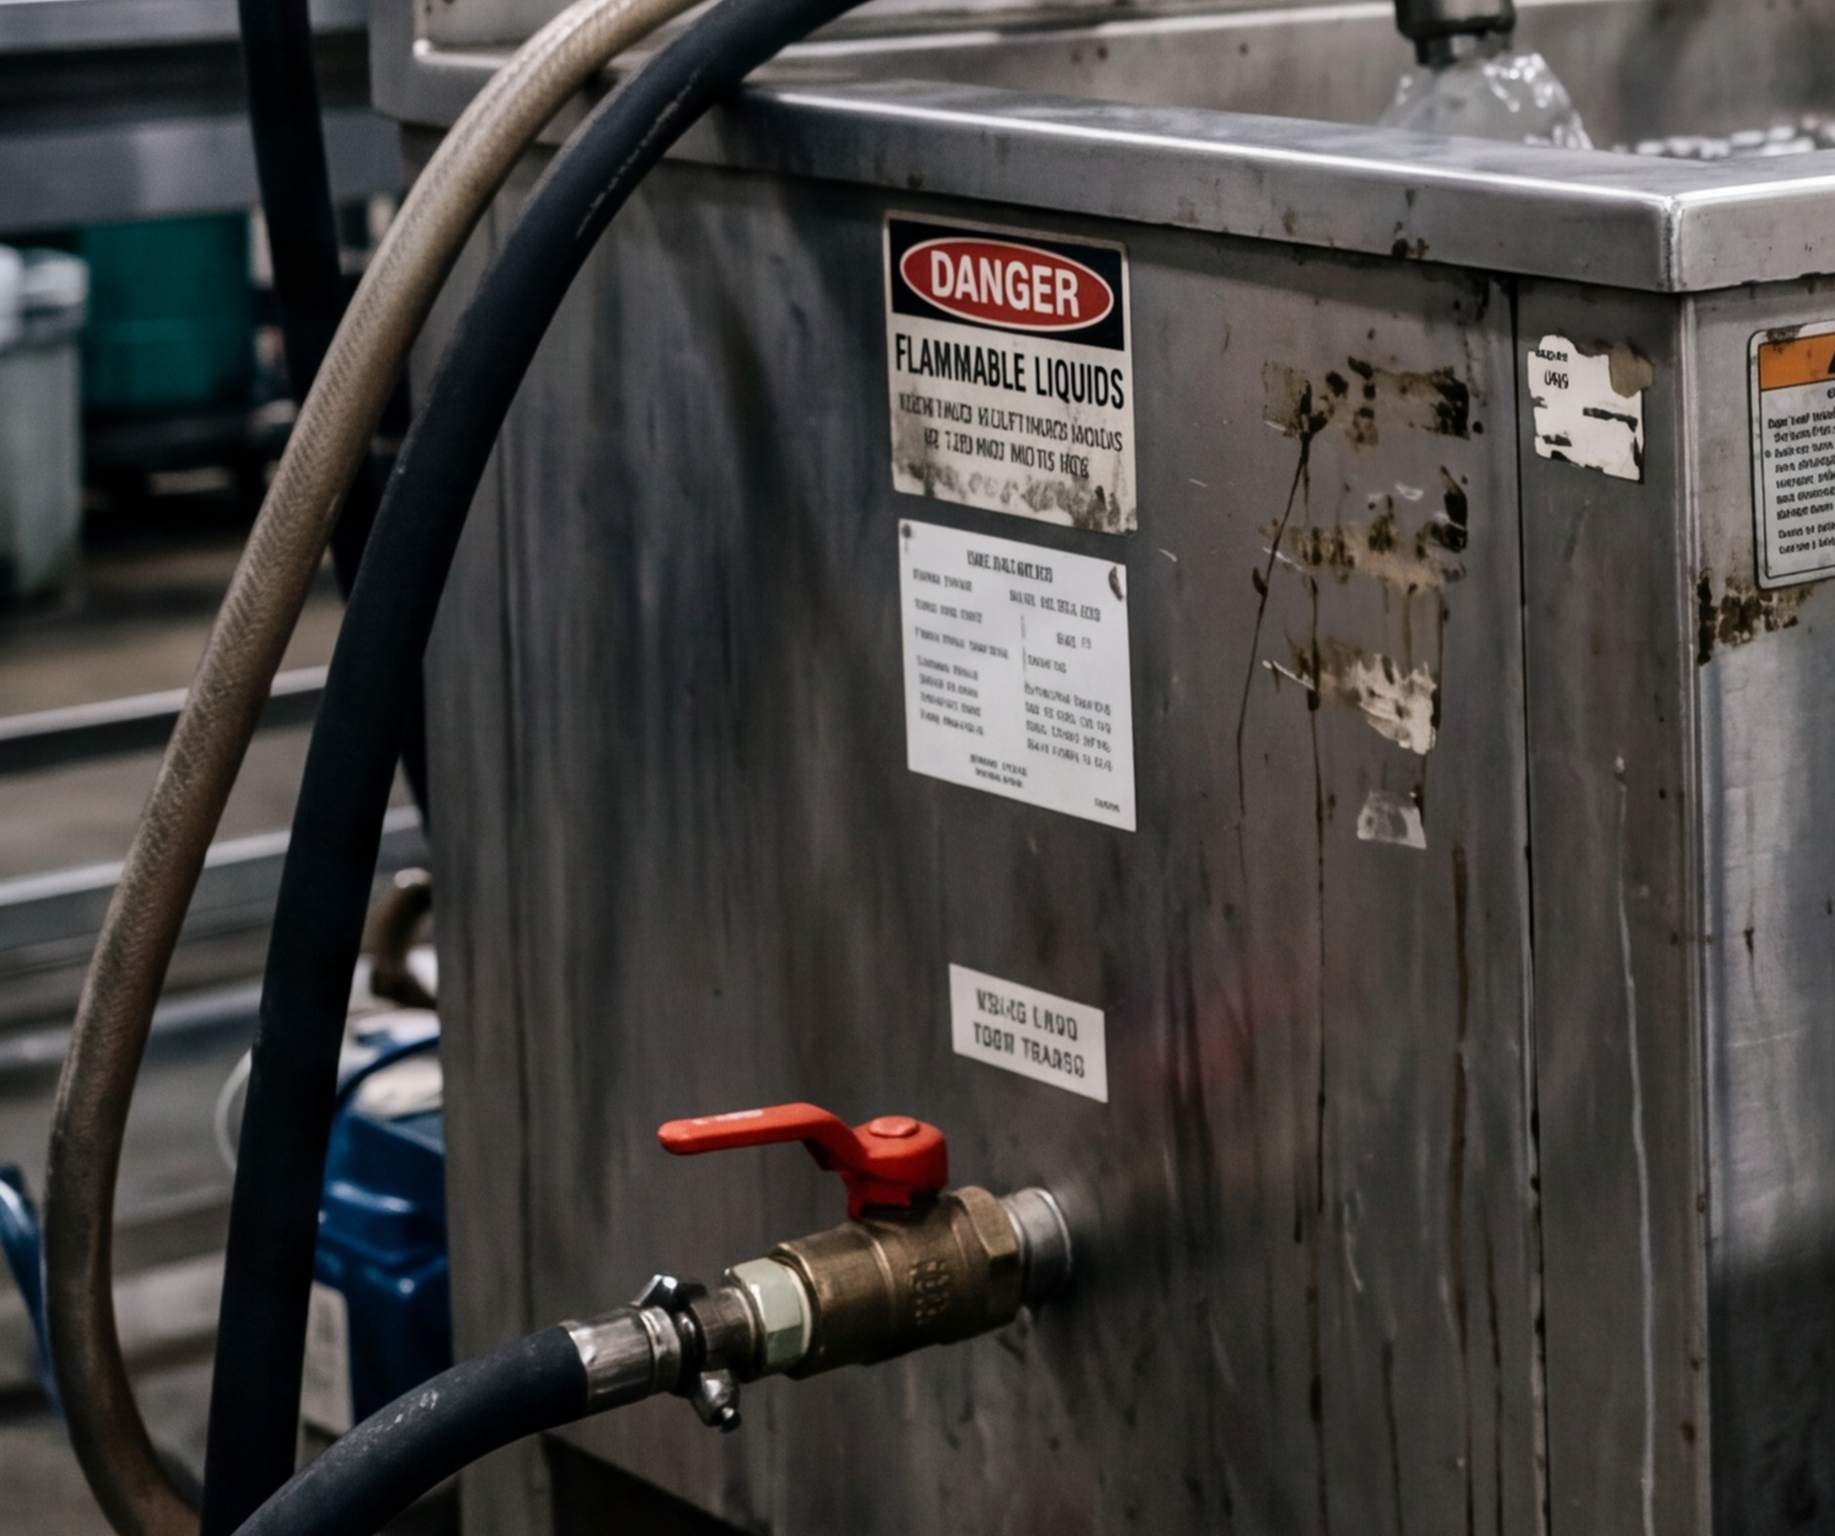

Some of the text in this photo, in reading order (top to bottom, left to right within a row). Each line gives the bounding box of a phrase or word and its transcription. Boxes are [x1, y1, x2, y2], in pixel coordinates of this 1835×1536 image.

[931, 250, 1079, 318] DANGER
[895, 333, 1124, 410] FLAMMABLE LIQUIDS
